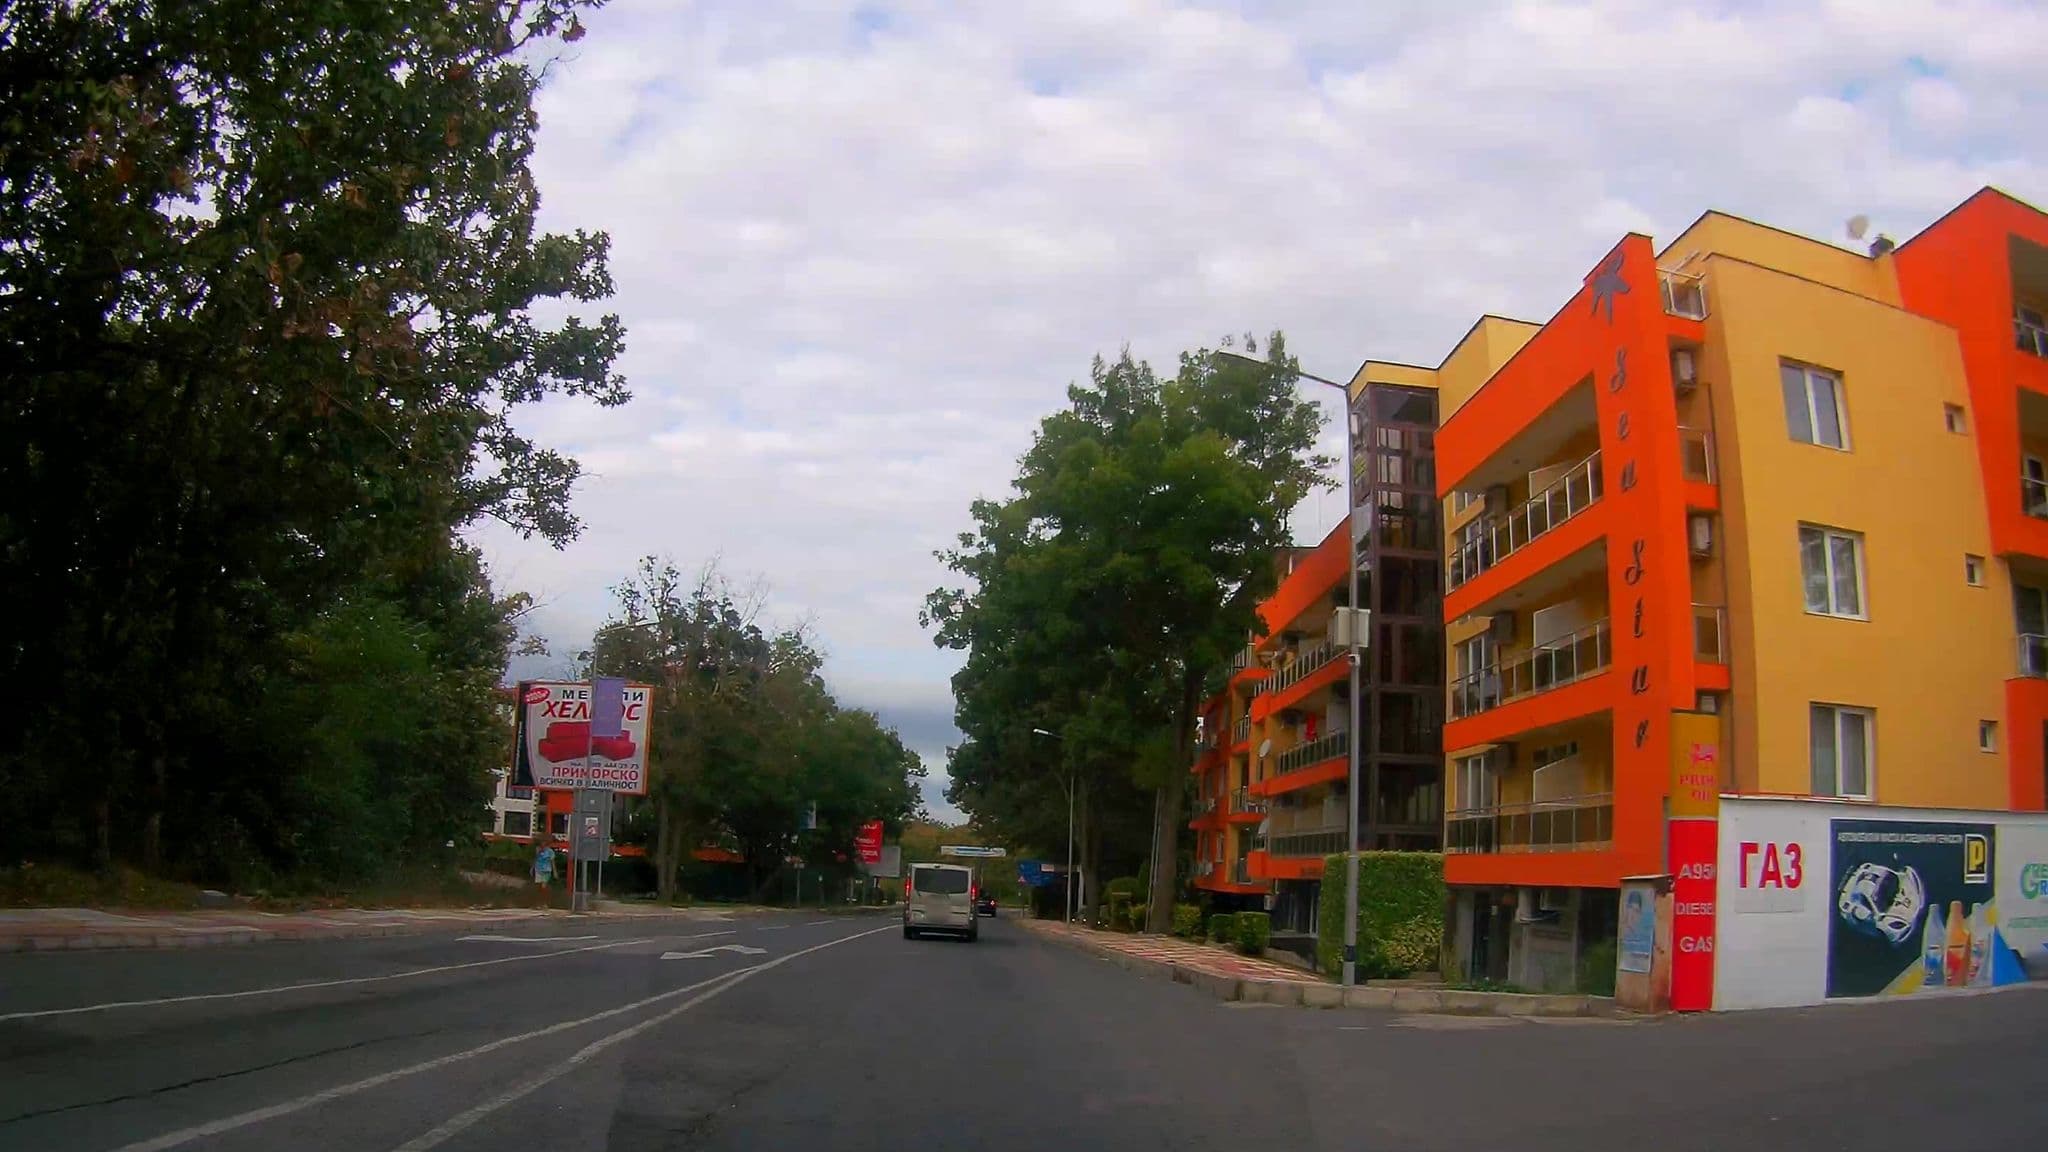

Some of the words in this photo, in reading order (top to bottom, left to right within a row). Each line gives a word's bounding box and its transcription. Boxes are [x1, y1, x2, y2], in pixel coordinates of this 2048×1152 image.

[562, 689, 644, 701] МЕЛИ
[541, 700, 643, 721] ХЕЛС
[1738, 842, 1803, 890] ГАЗ
